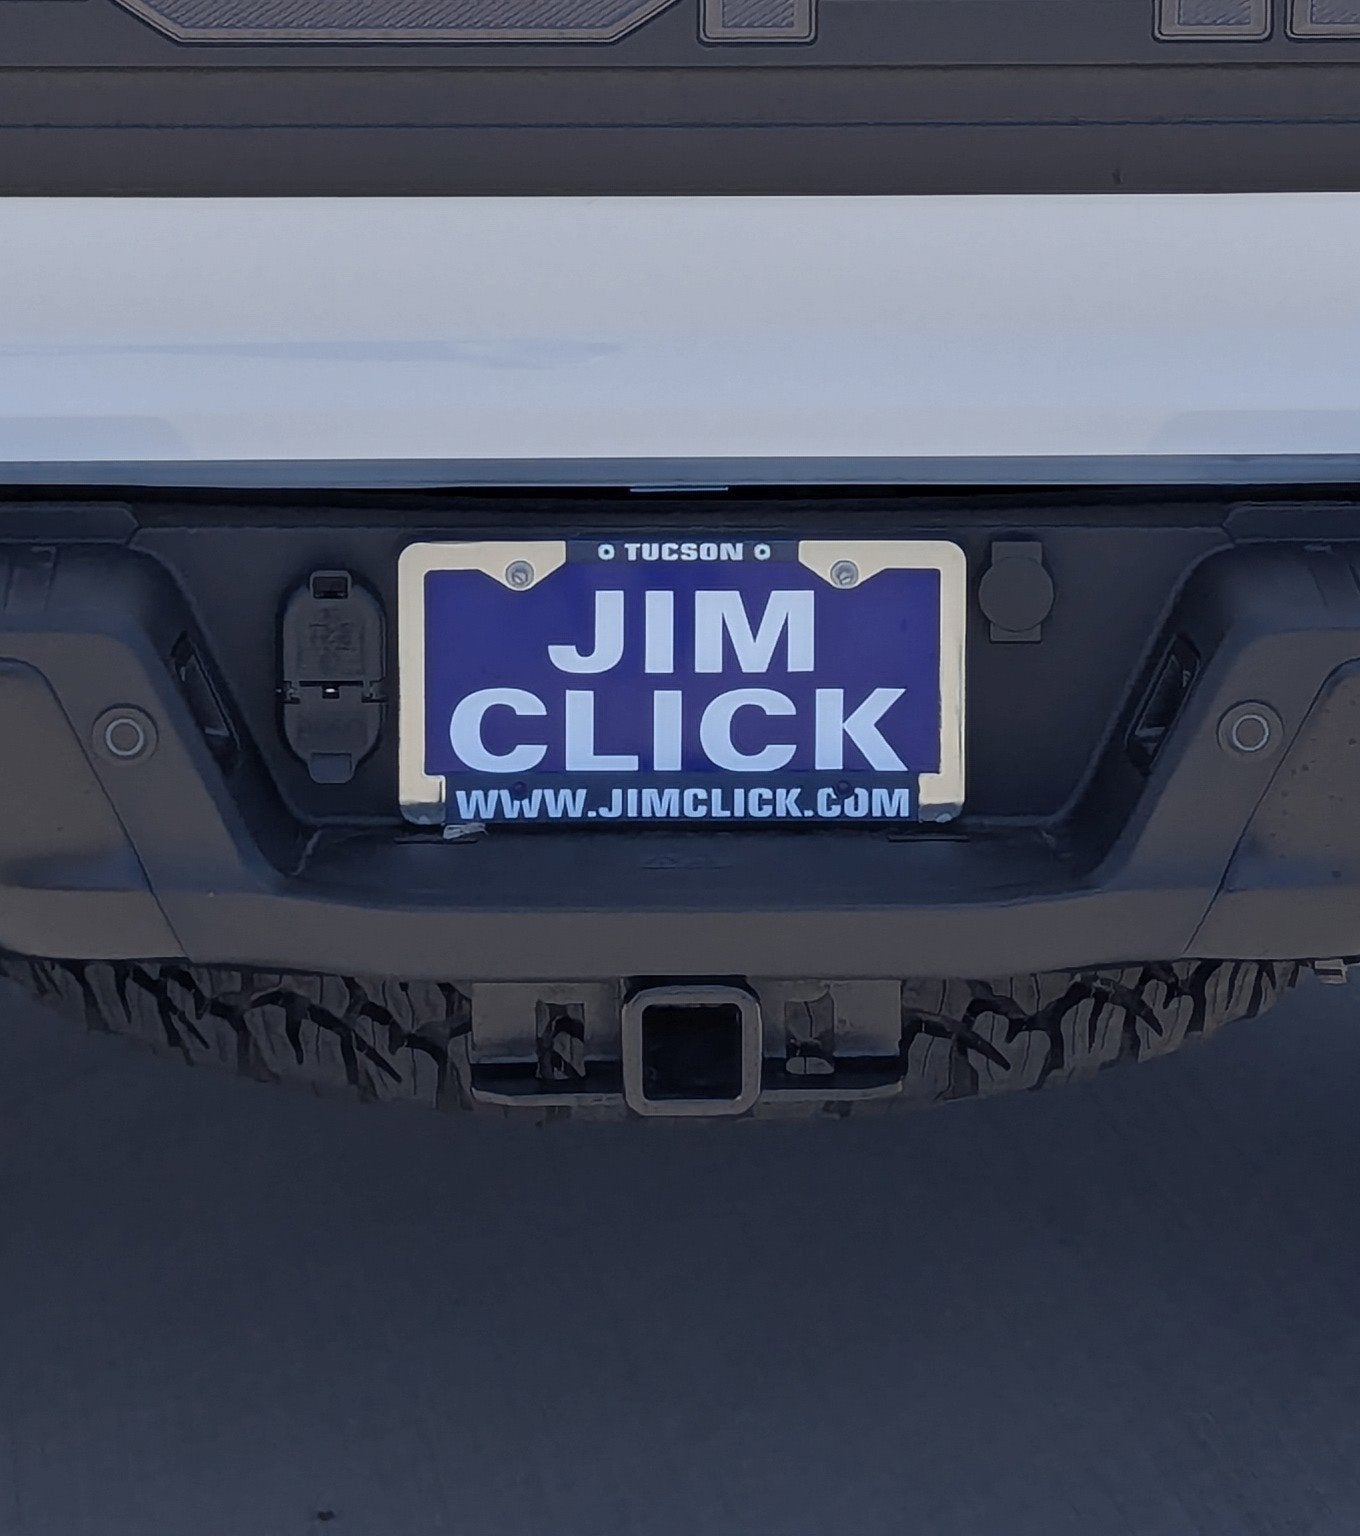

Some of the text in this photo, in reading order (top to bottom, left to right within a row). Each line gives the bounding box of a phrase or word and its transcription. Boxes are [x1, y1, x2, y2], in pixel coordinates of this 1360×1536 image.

[624, 542, 743, 562] TUCSON
[547, 589, 815, 674] JIM
[448, 687, 909, 772] CLICK
[455, 787, 910, 820] WWW.JIMCLICK.COM
